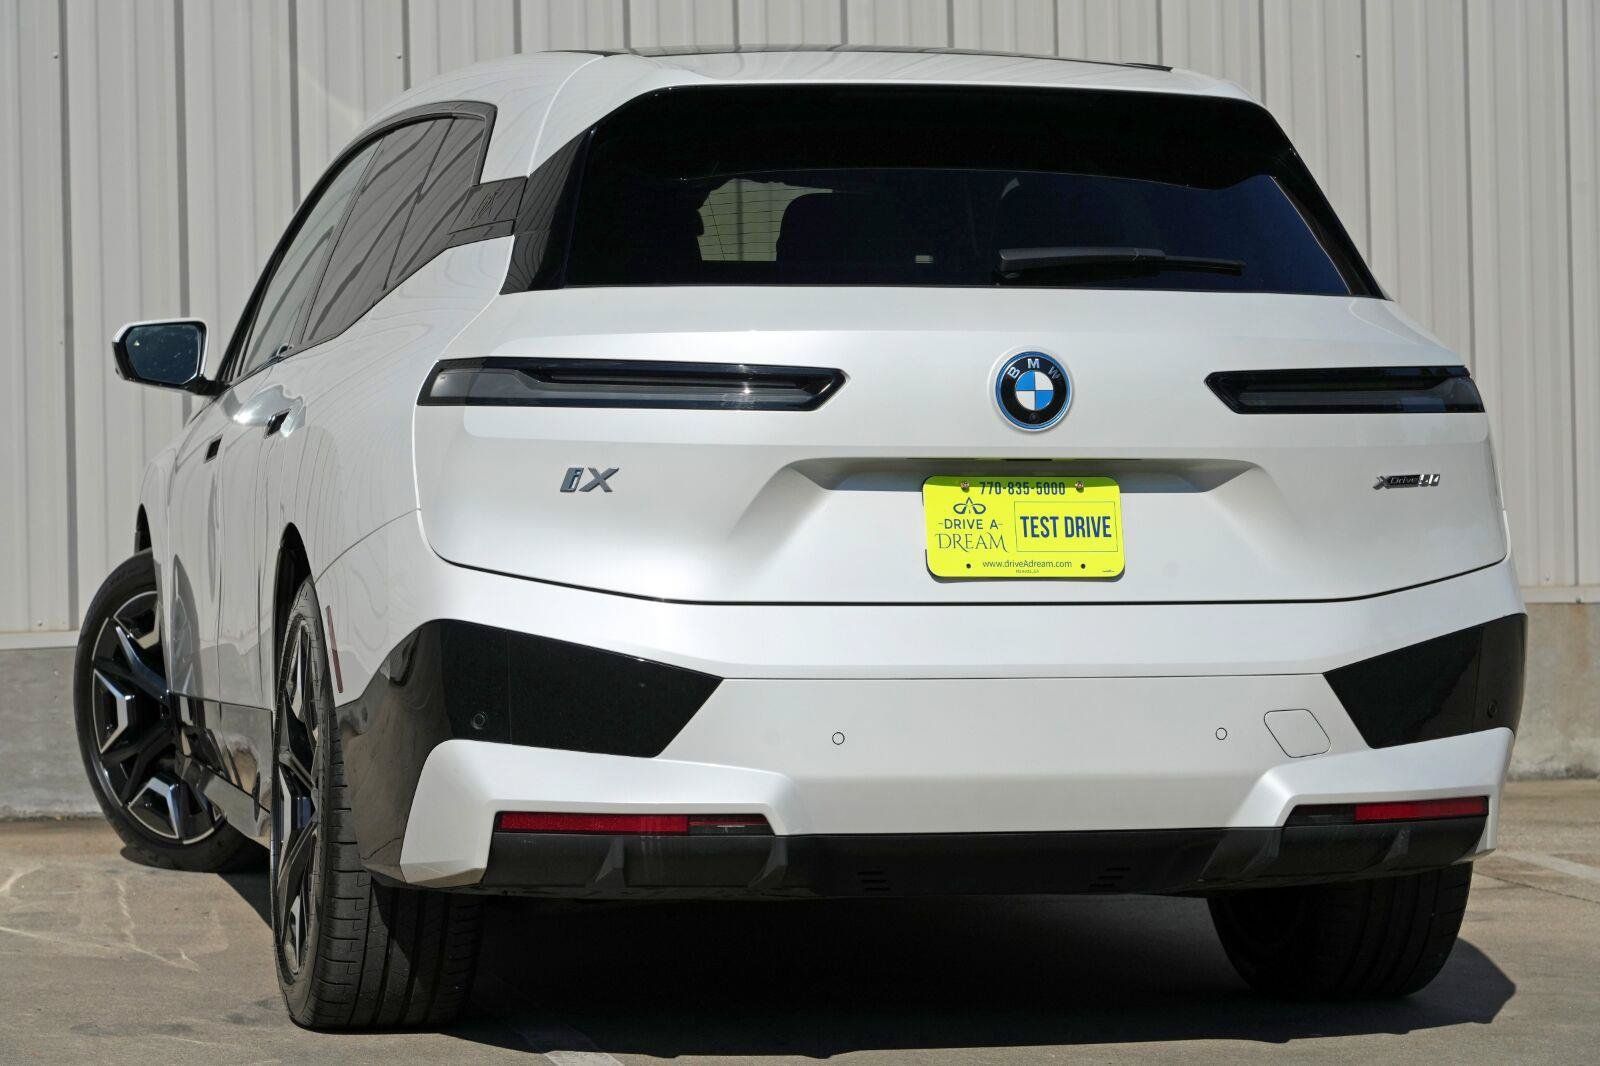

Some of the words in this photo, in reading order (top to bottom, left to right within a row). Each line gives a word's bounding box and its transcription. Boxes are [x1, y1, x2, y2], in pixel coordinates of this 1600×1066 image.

[1007, 358, 1061, 380] BMW
[560, 466, 620, 493] iX
[979, 481, 1066, 495] 770-835-5000
[944, 518, 984, 530] DRIVE
[1020, 515, 1060, 538] TEST
[1064, 515, 1112, 538] DRIVE
[935, 532, 1009, 552] DREAM
[982, 559, 1073, 568] www.driveAdream.com
